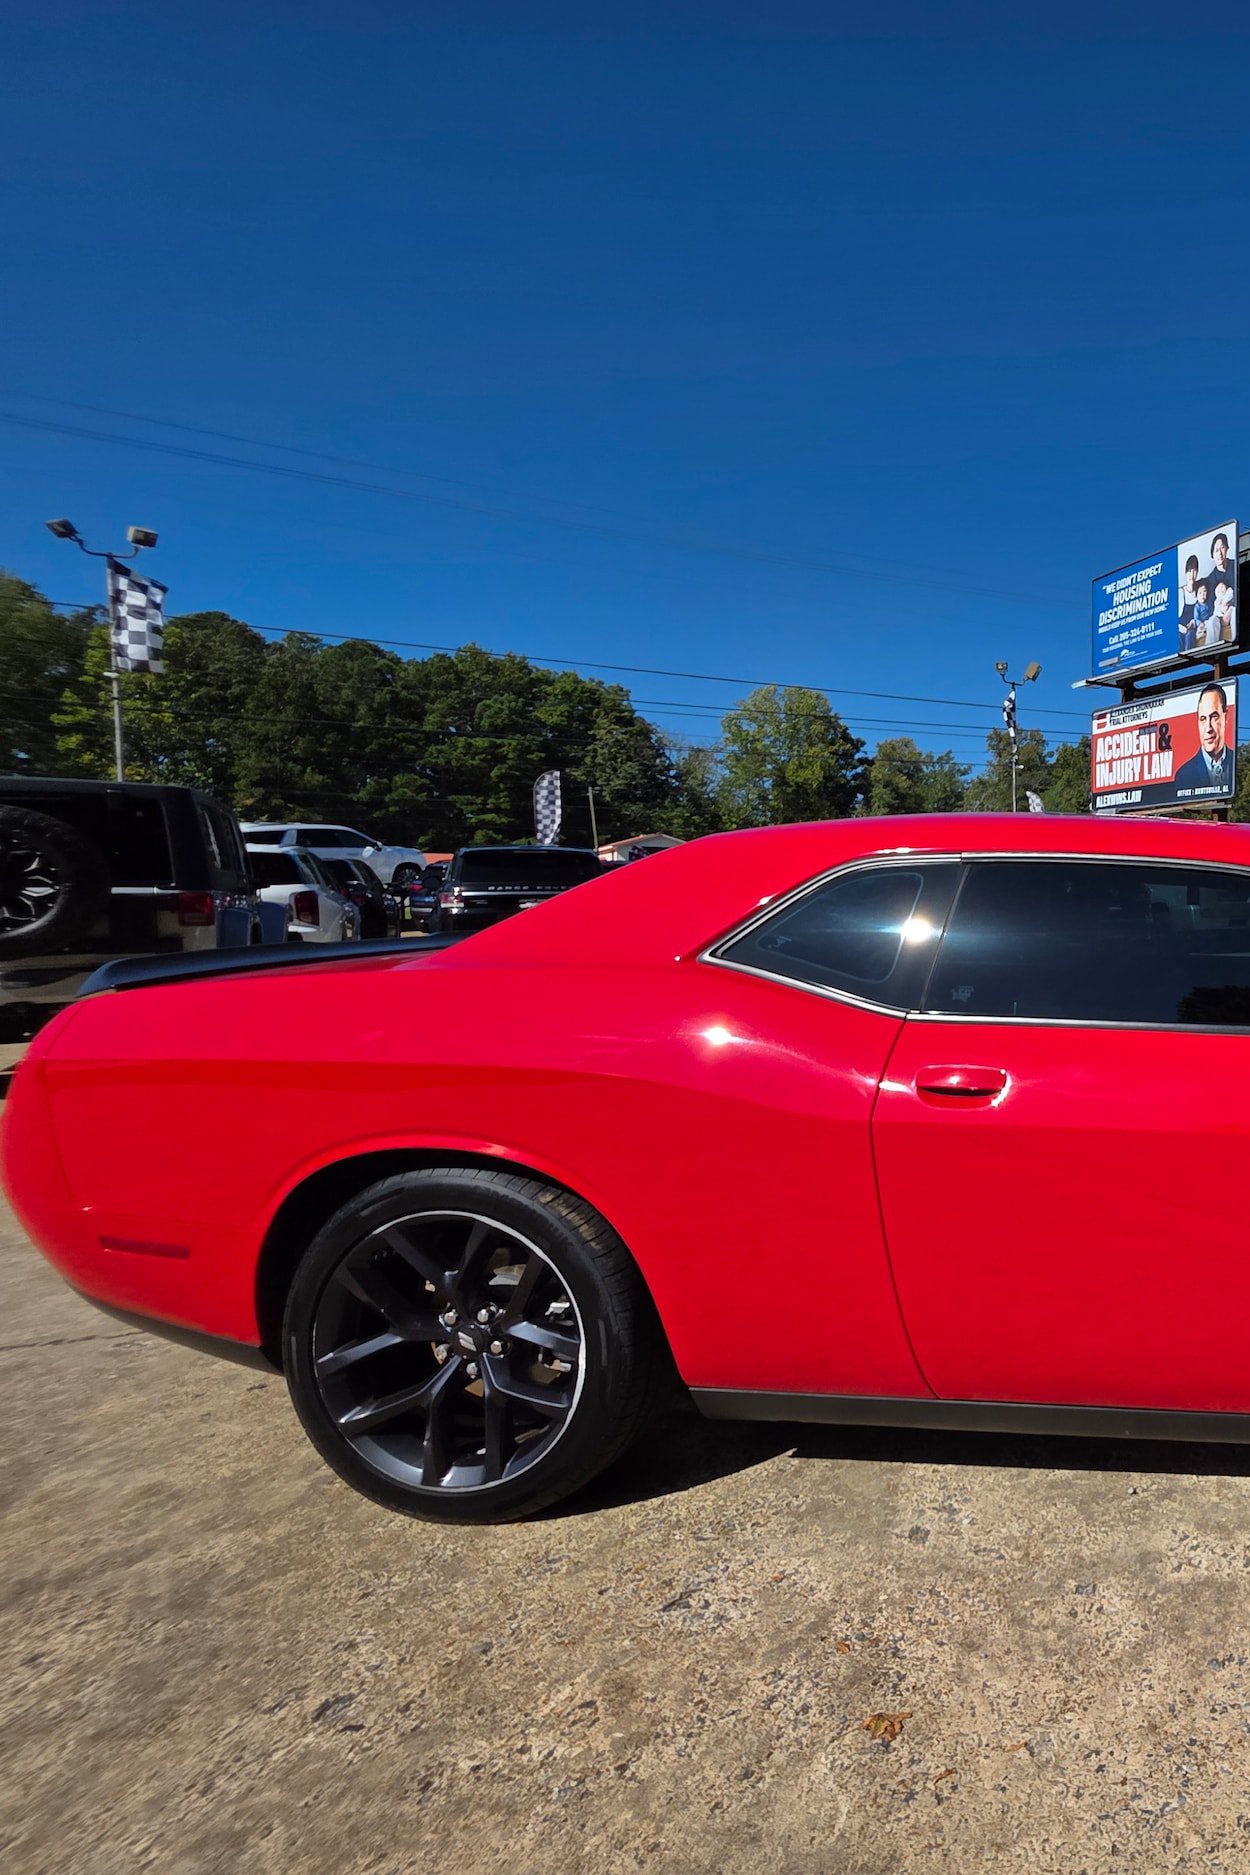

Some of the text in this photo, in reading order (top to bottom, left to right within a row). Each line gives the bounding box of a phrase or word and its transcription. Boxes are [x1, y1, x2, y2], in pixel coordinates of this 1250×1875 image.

[1113, 579, 1151, 606] HOUSING
[1116, 573, 1137, 590] DIDN'T
[1137, 563, 1163, 581] EXPECT
[1098, 588, 1168, 627] DISCRIMINATION
[1096, 723, 1172, 763] ACCIDENT &
[1096, 751, 1173, 788] INJURY LAW
